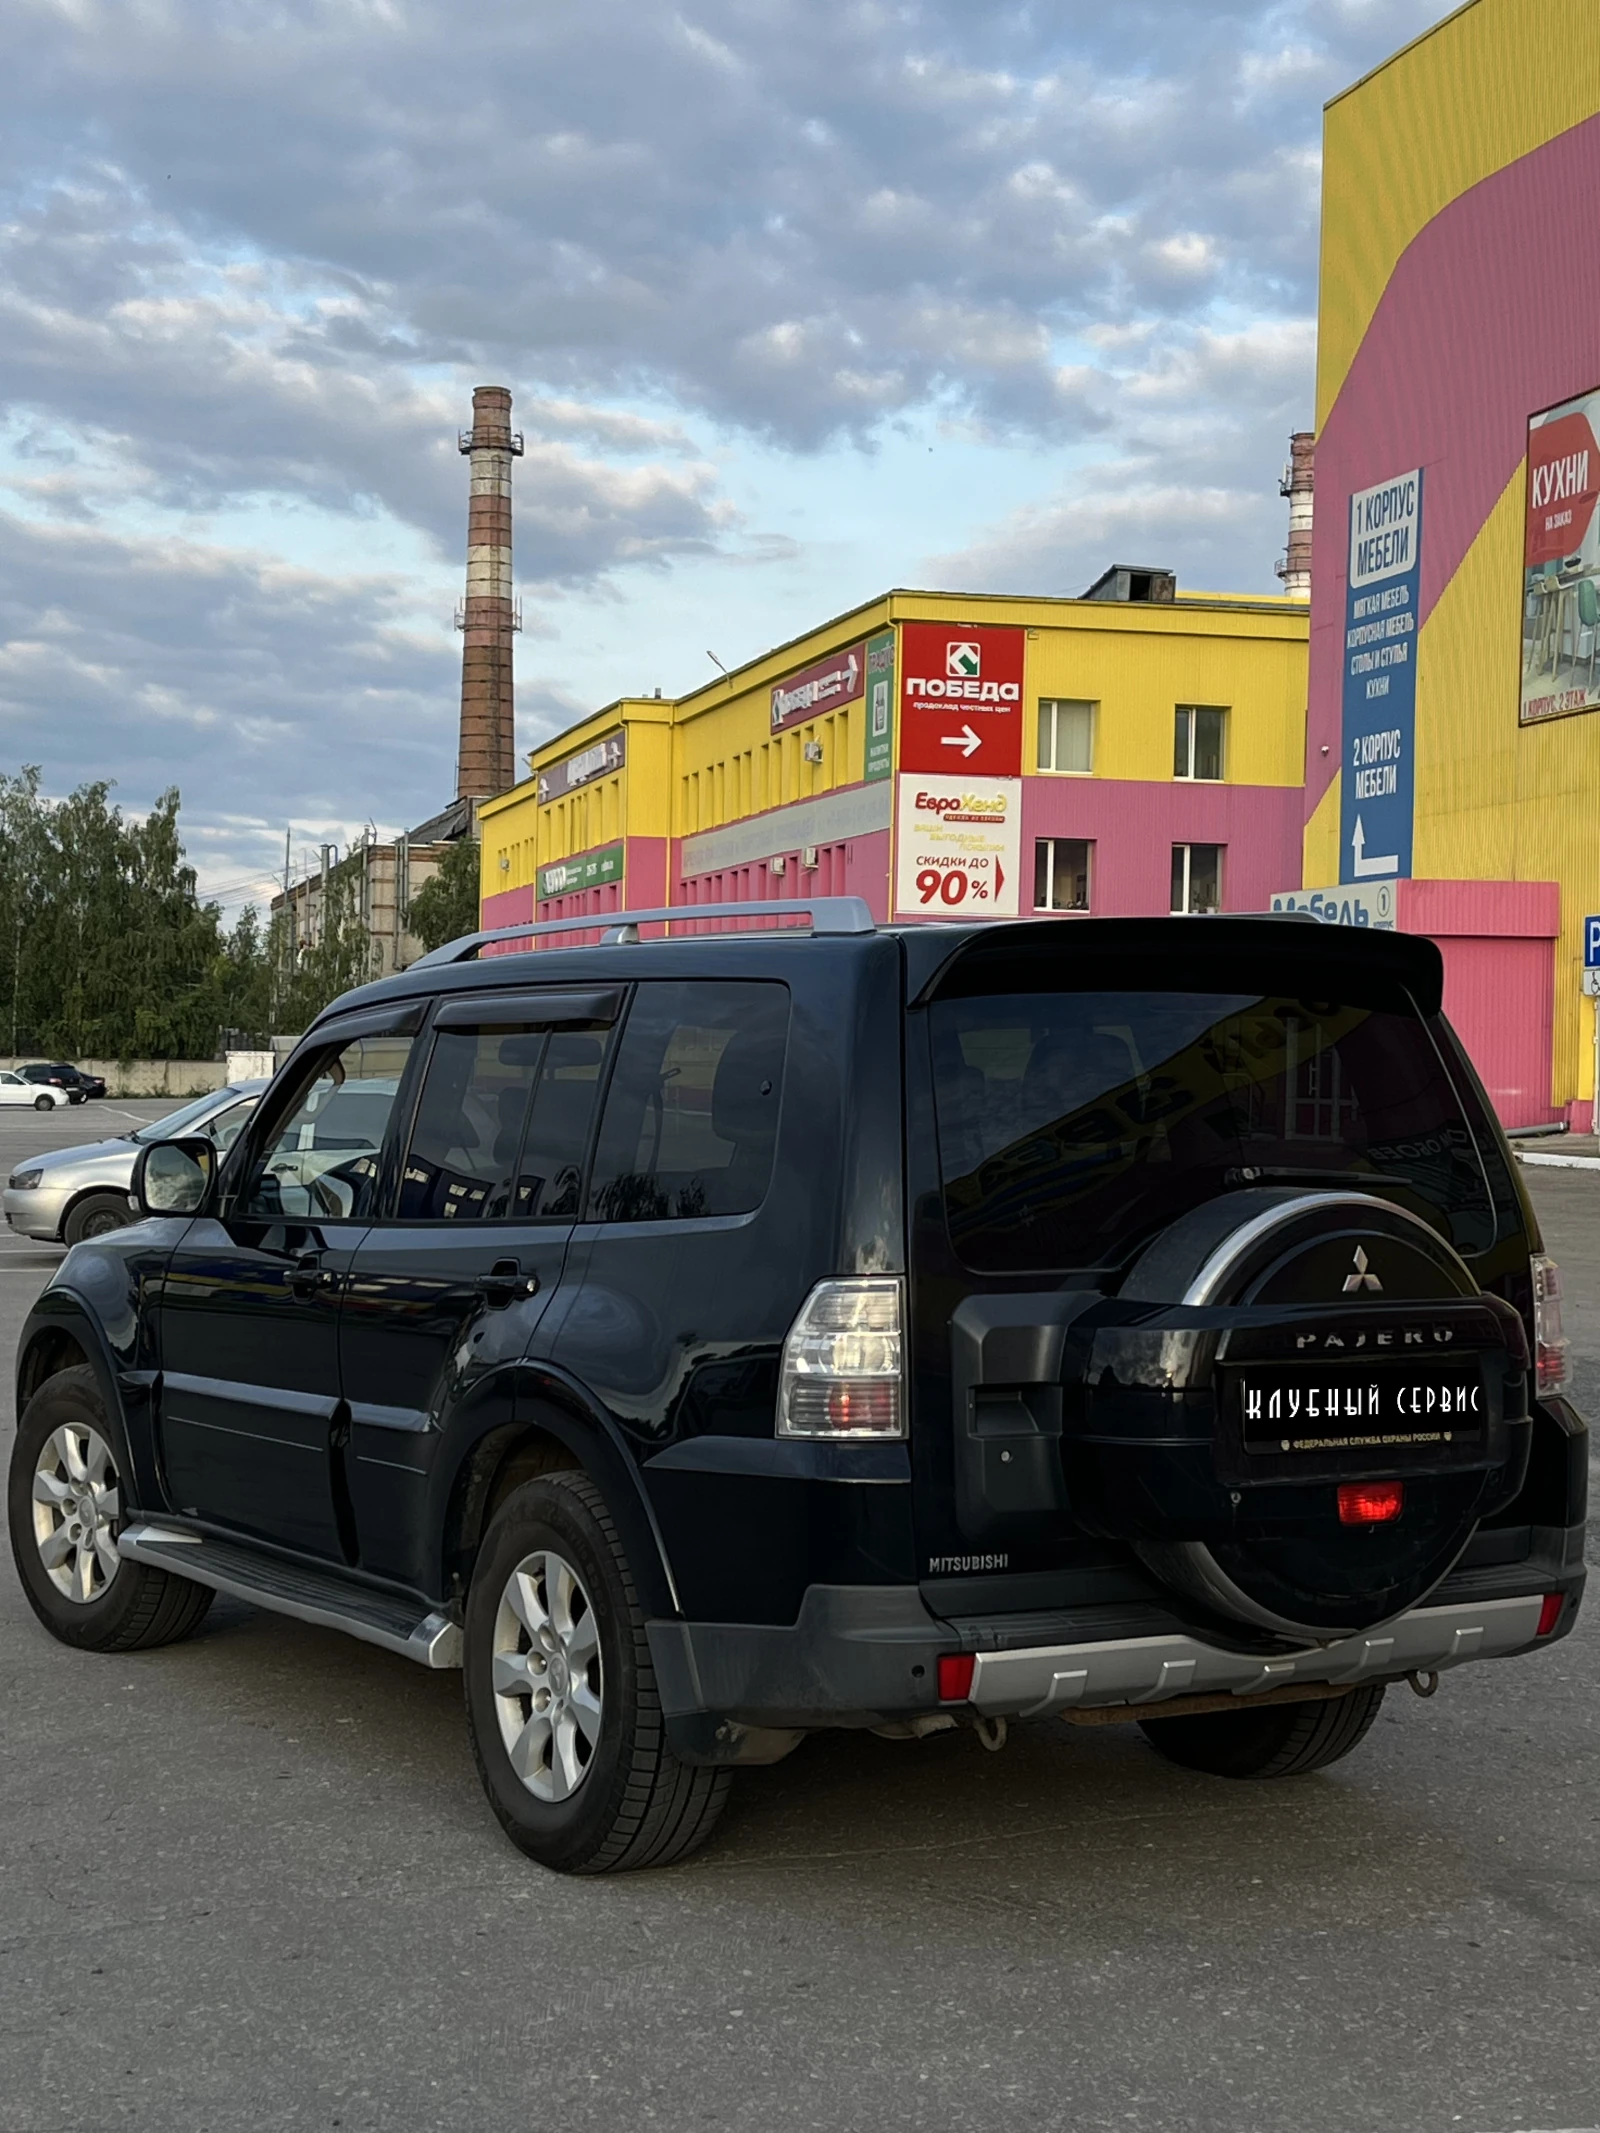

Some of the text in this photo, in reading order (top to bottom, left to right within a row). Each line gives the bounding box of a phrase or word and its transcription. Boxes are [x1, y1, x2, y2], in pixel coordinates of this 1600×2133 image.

[1532, 449, 1588, 509] КУХНИ
[1357, 481, 1414, 535] 1 КОРПУС
[1357, 526, 1409, 577] МЕБЕЛИ
[1353, 584, 1409, 619] МЯГКАЯ МЕБЕЛЬ
[1347, 612, 1414, 649] КОРПУСНАЯ МЕБЕЛЬ
[1351, 641, 1408, 675] СТОЛЫ И СТУЛЬЯ
[906, 678, 1020, 702] ПОБЕДА
[1366, 675, 1390, 699] КУХНИ
[1353, 729, 1401, 766] 2 КОРПУС
[1355, 764, 1397, 800] МЕБЕЛИ
[915, 792, 1007, 815] ЕвроХенд
[916, 856, 989, 869] СКИДКИ ДО
[916, 869, 988, 905] 90%
[1297, 1330, 1453, 1348] PAJERO
[1293, 1432, 1441, 1449] ФЕДЕРАЛЬНАЯ СЛУЖБА ОХРАНЫ РОССИИ
[929, 1553, 1009, 1573] MITSUBISHI
